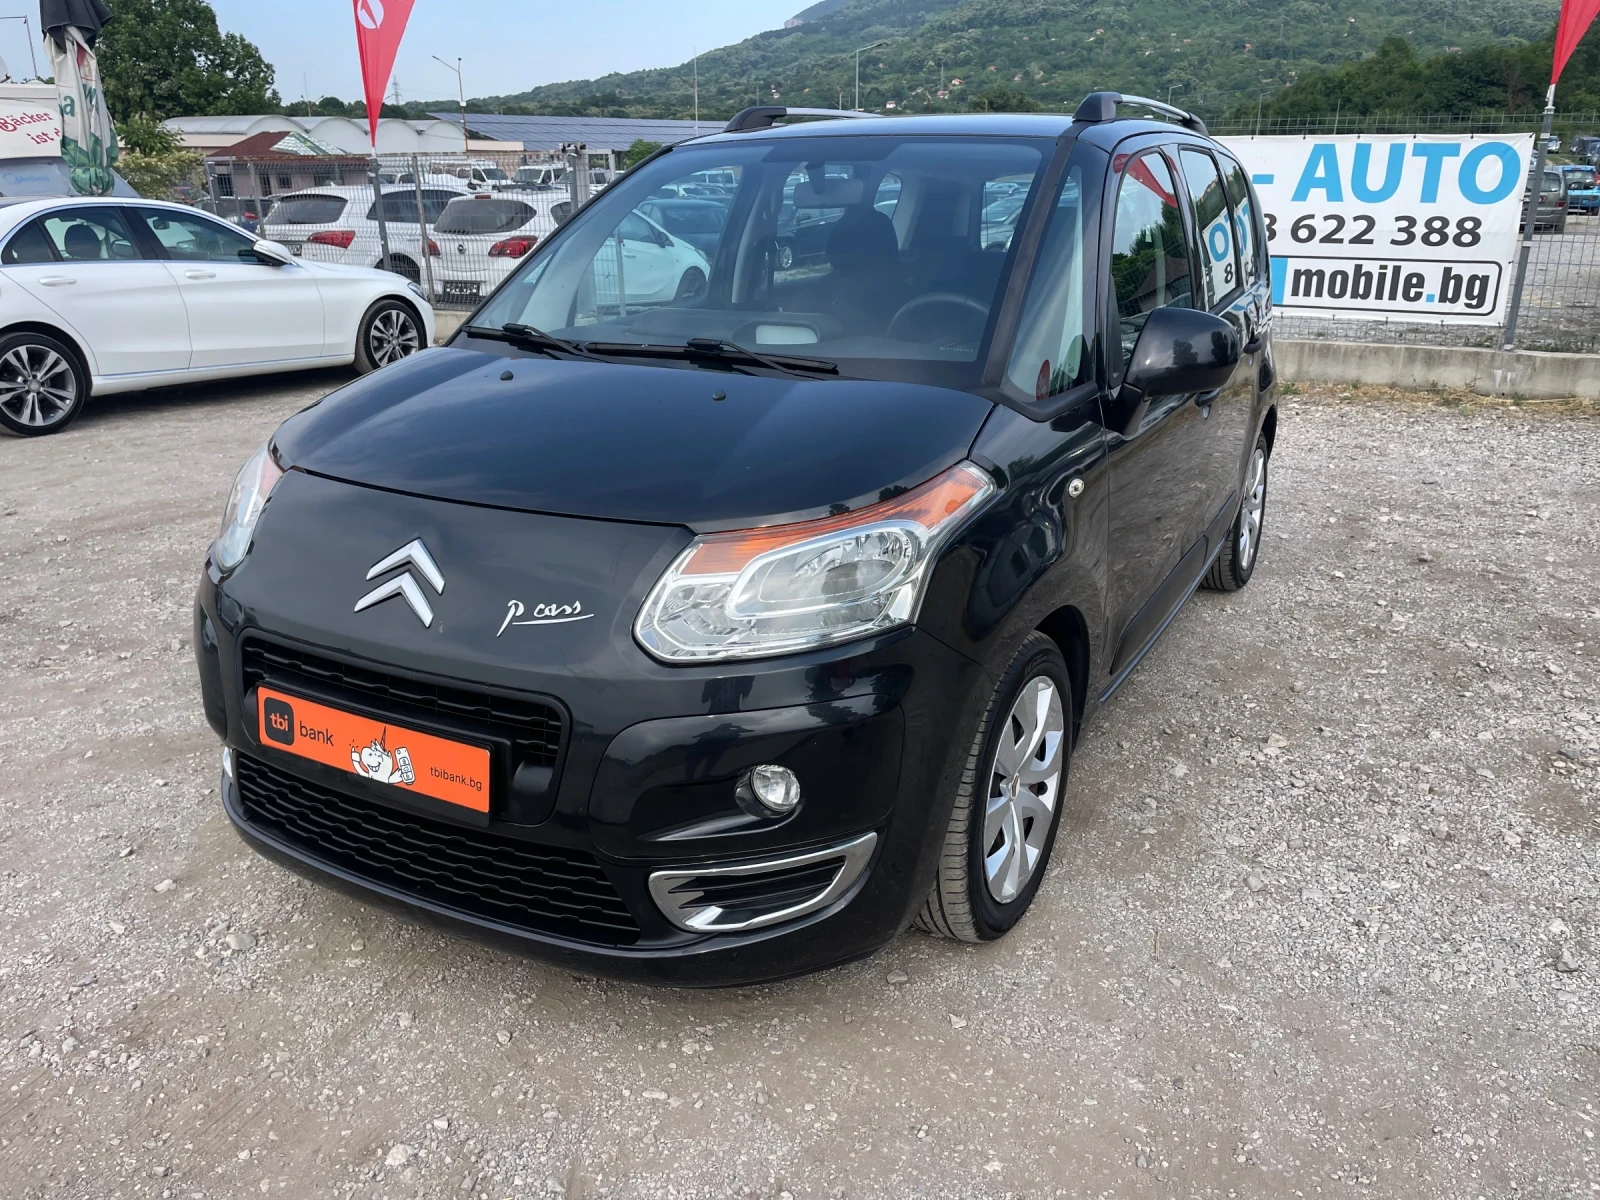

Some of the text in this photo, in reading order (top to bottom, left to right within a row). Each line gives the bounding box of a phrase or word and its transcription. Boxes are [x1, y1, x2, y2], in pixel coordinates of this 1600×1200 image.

[26, 132, 55, 144] ist
[1291, 142, 1520, 204] AUTO
[1290, 214, 1376, 245] 622
[1390, 215, 1483, 247] 388
[1290, 264, 1490, 309] mobile.bg
[270, 713, 334, 747] tbi bank
[430, 766, 482, 792] tbibank.bg
